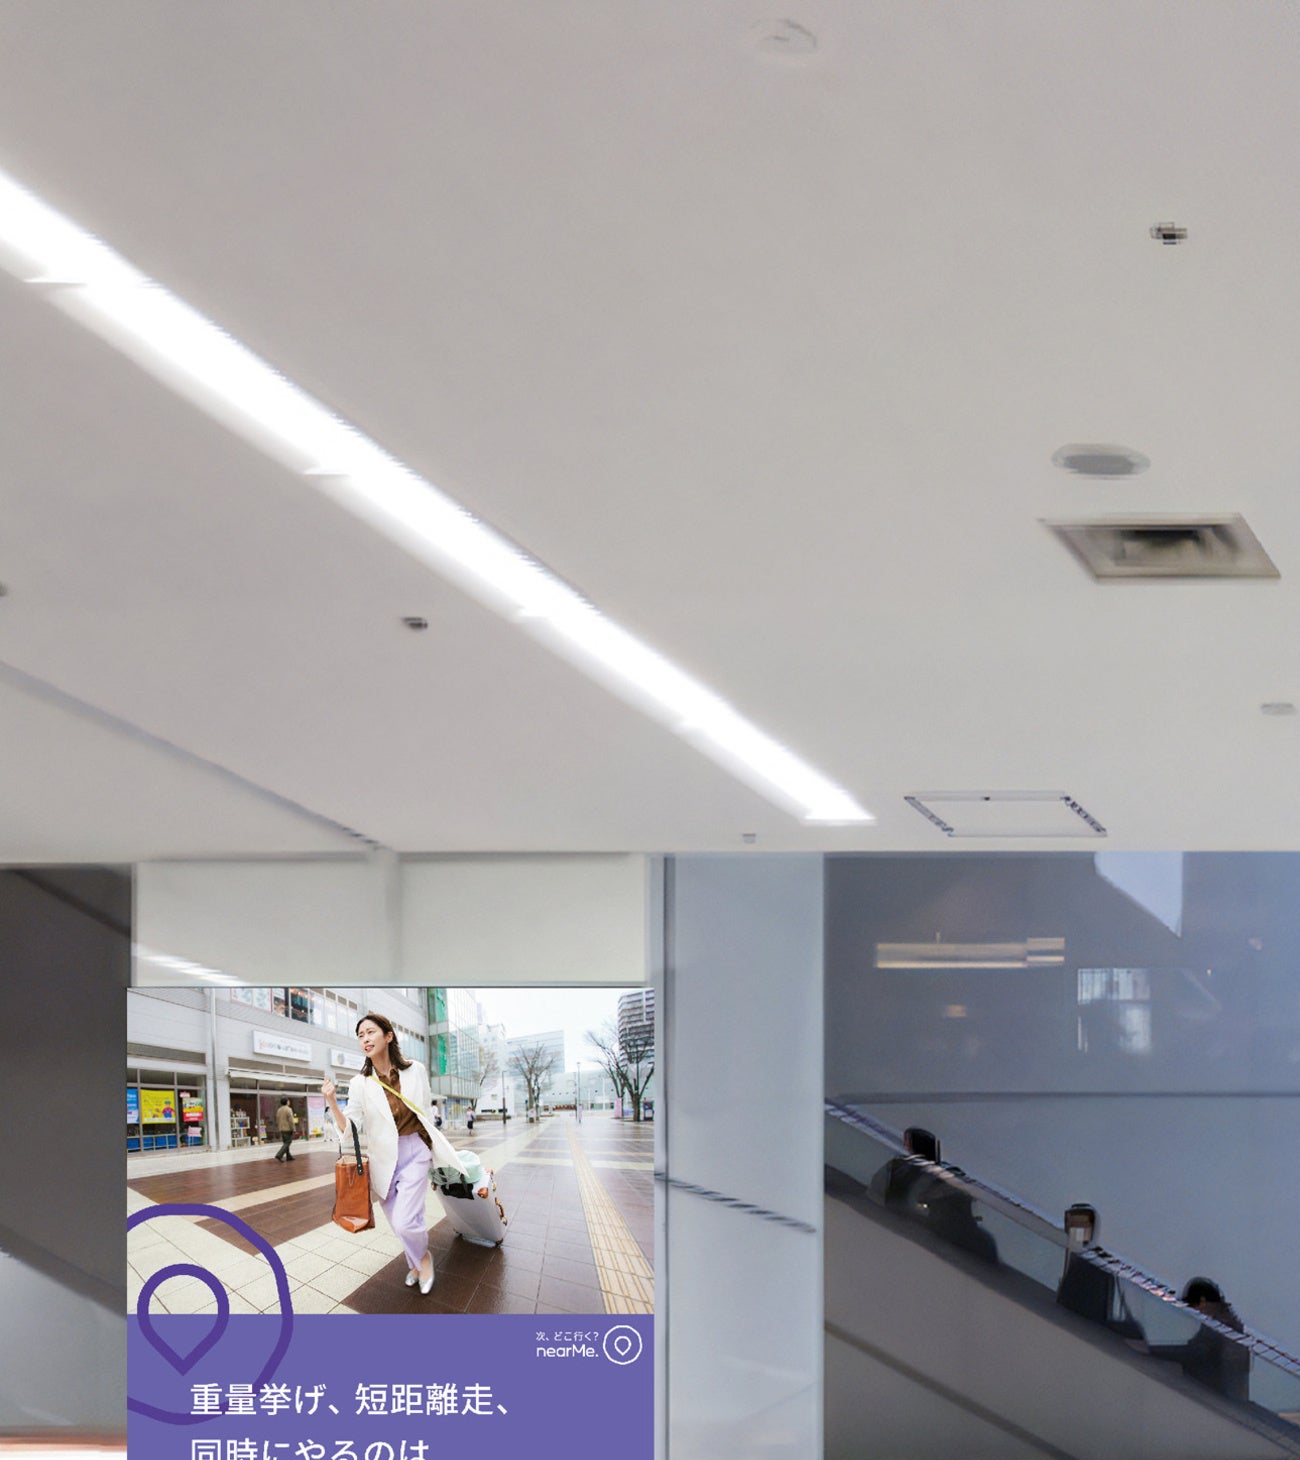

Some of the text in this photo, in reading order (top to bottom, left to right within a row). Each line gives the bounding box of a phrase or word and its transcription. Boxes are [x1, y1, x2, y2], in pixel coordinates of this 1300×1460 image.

[536, 1343, 599, 1358] nearMe.
[190, 1382, 508, 1416] 重量挙げ、短距離走、
